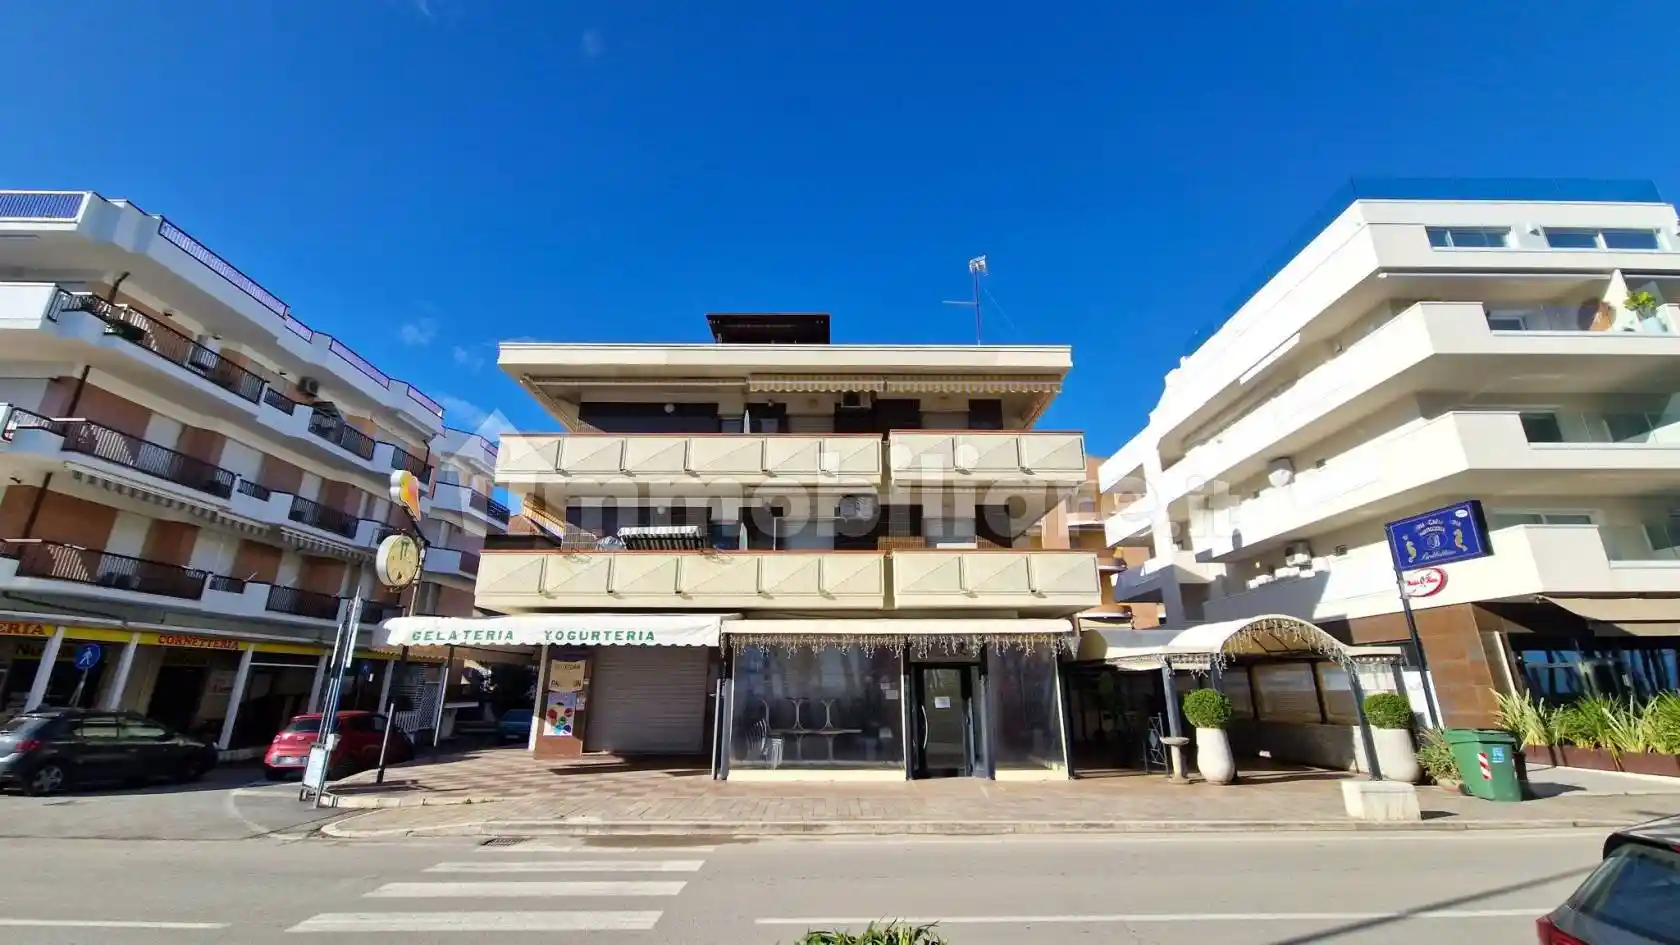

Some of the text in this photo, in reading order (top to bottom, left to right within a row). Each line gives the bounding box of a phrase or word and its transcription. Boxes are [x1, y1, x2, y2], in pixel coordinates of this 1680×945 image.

[158, 635, 239, 650] CORNETTERIA
[411, 629, 656, 642] GELATERIA YOGURTERIA
